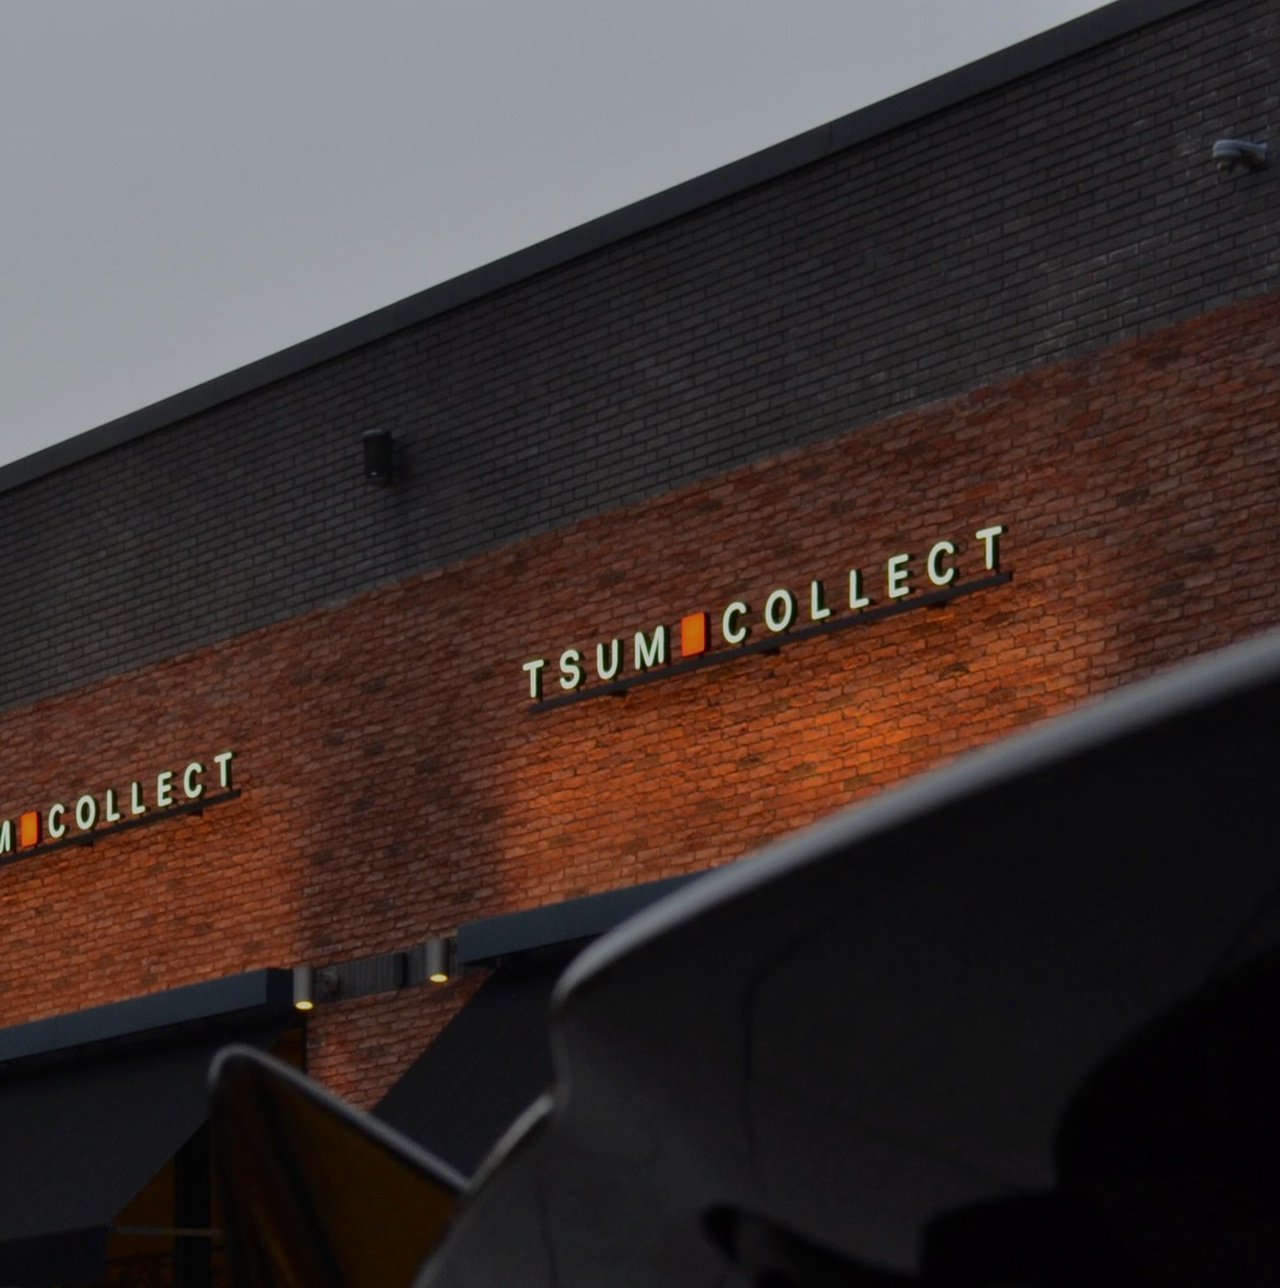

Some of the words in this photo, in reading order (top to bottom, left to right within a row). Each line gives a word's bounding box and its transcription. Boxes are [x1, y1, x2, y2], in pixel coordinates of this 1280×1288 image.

[522, 624, 668, 698] TSUM
[721, 524, 1006, 645] COLLECT
[47, 751, 234, 839] COLLECT
